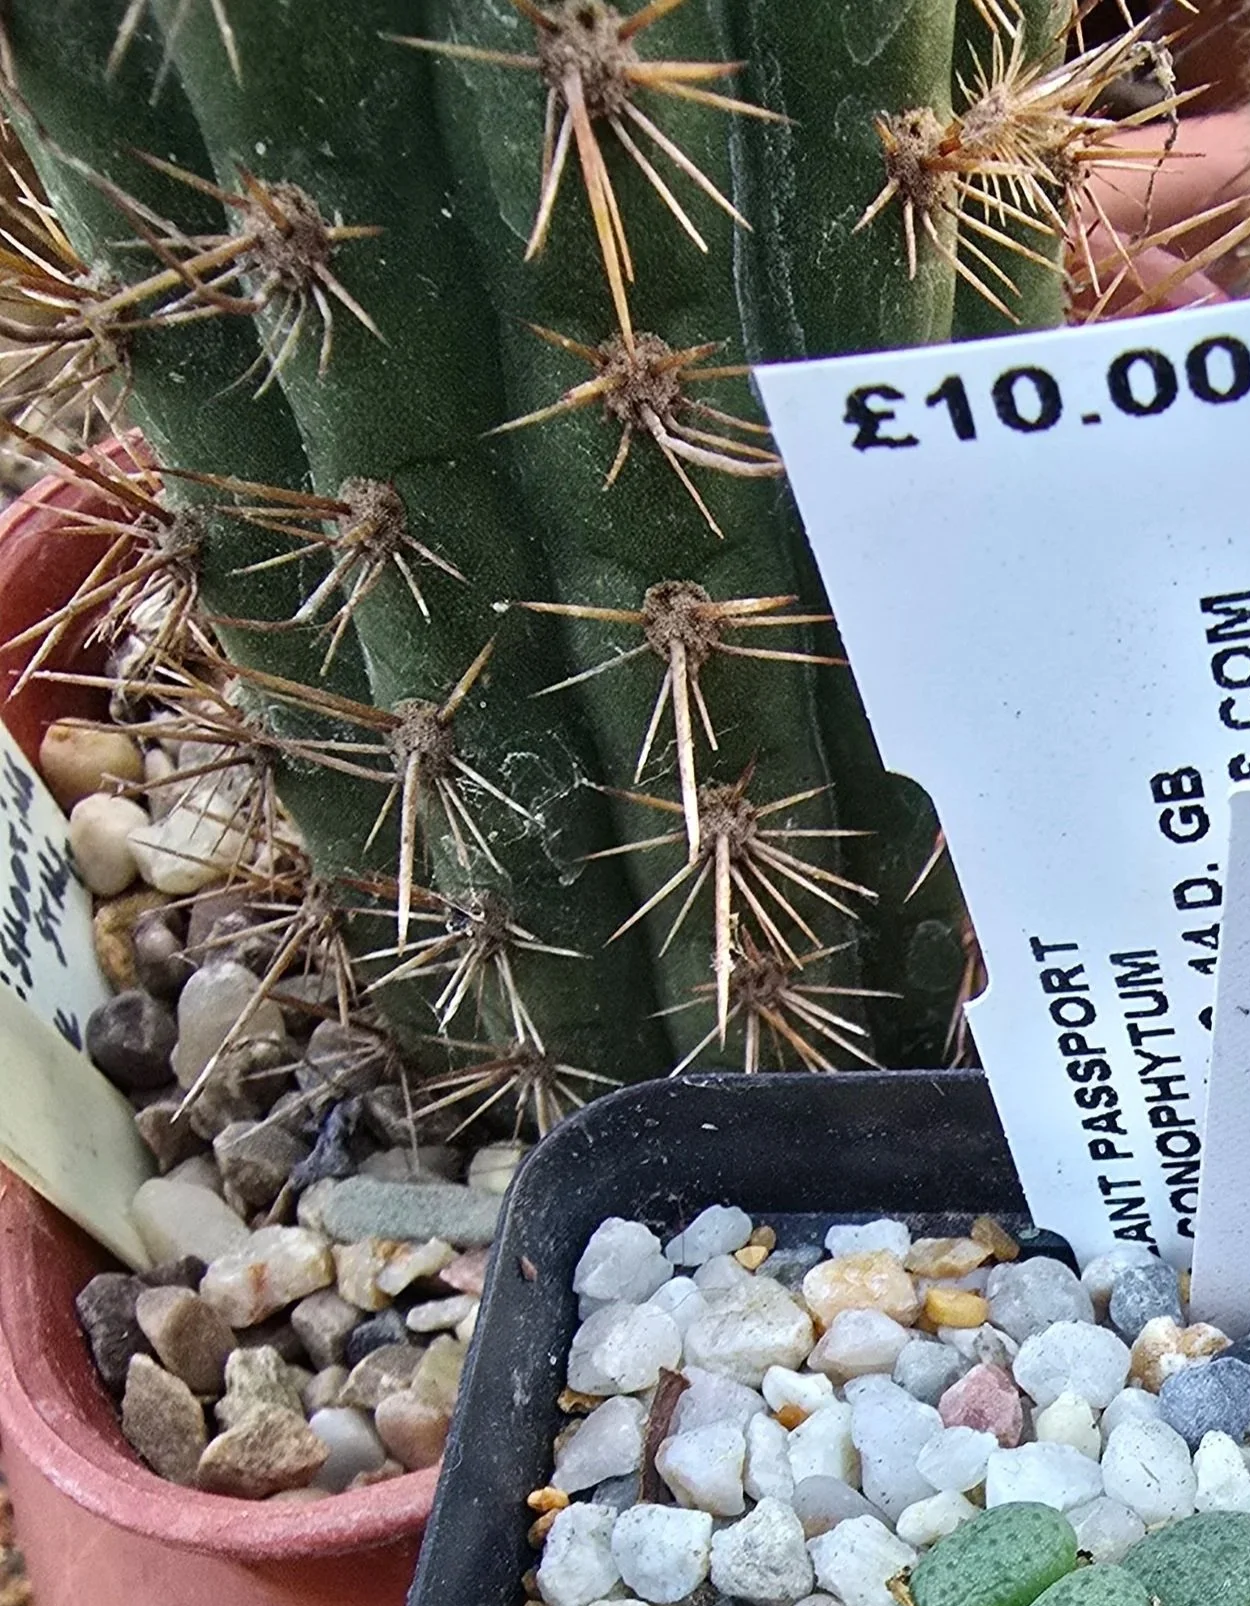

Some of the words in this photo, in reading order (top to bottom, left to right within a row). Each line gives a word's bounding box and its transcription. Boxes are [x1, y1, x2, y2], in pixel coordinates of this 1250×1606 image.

[1149, 765, 1211, 844] GB
[1172, 862, 1224, 911] D.
[1029, 935, 1135, 1161] PASSPORT
[1097, 1174, 1161, 1258] ANT
